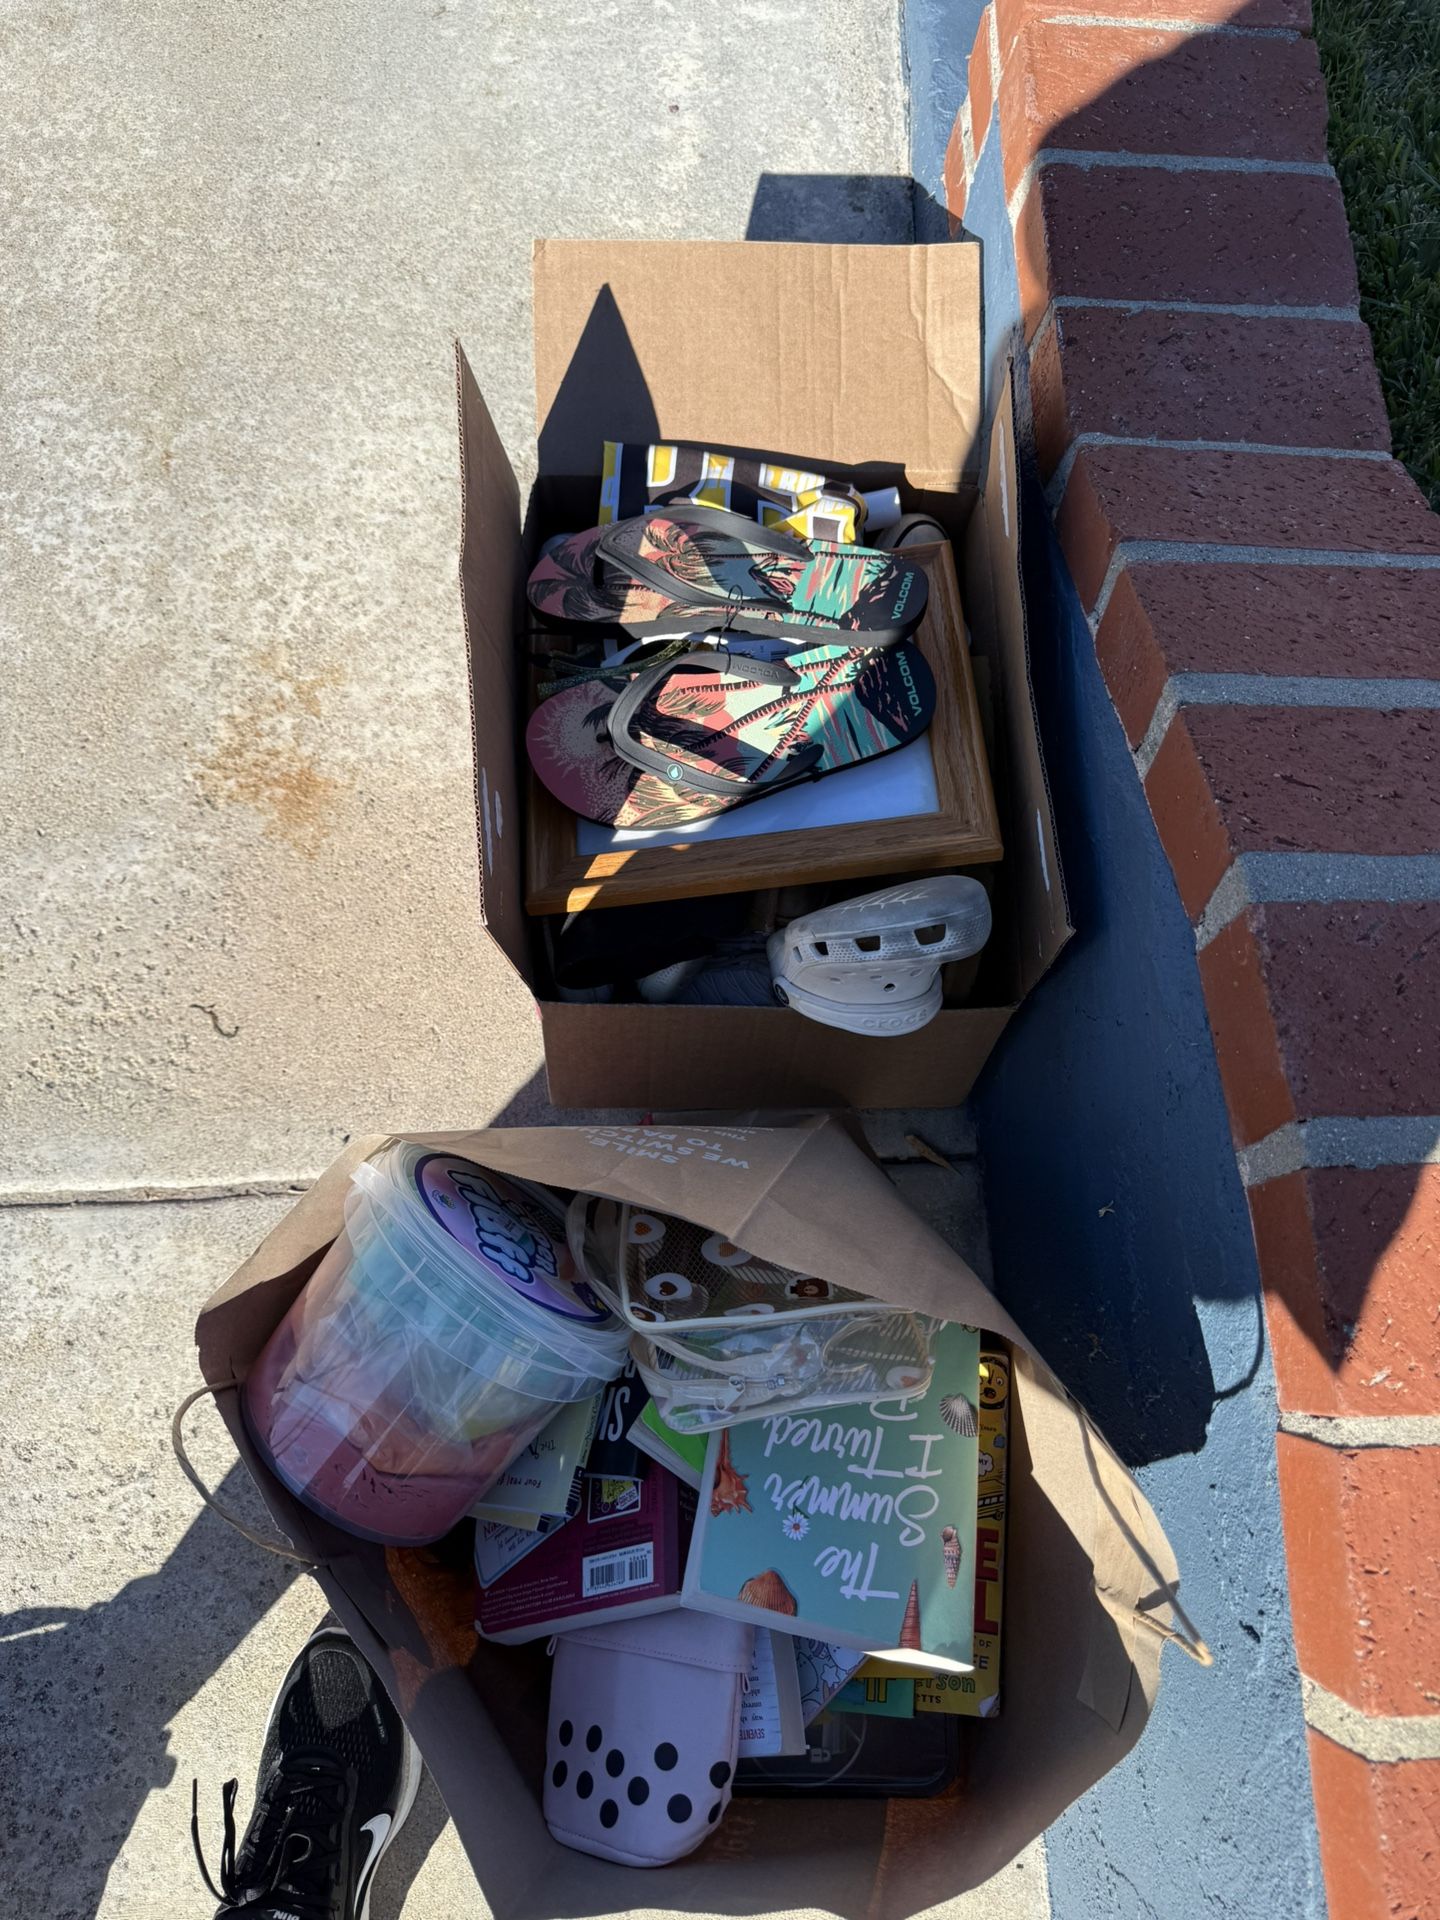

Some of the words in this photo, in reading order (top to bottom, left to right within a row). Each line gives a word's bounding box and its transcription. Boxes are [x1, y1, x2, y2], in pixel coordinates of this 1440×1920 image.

[891, 571, 915, 620] VOLCOM
[732, 663, 780, 681] VOLCOM
[895, 651, 922, 717] VOLCOM
[863, 1009, 928, 1029] crocs
[574, 1126, 695, 1155] SWITCH
[687, 1137, 723, 1152] TO
[702, 1151, 750, 1169] WE
[762, 1415, 905, 1480] Turned
[905, 1434, 945, 1479] I
[764, 1473, 940, 1547] Summer
[814, 1542, 900, 1602] The
[979, 1639, 993, 1649] OF
[739, 1728, 765, 1740] SEVENTE
